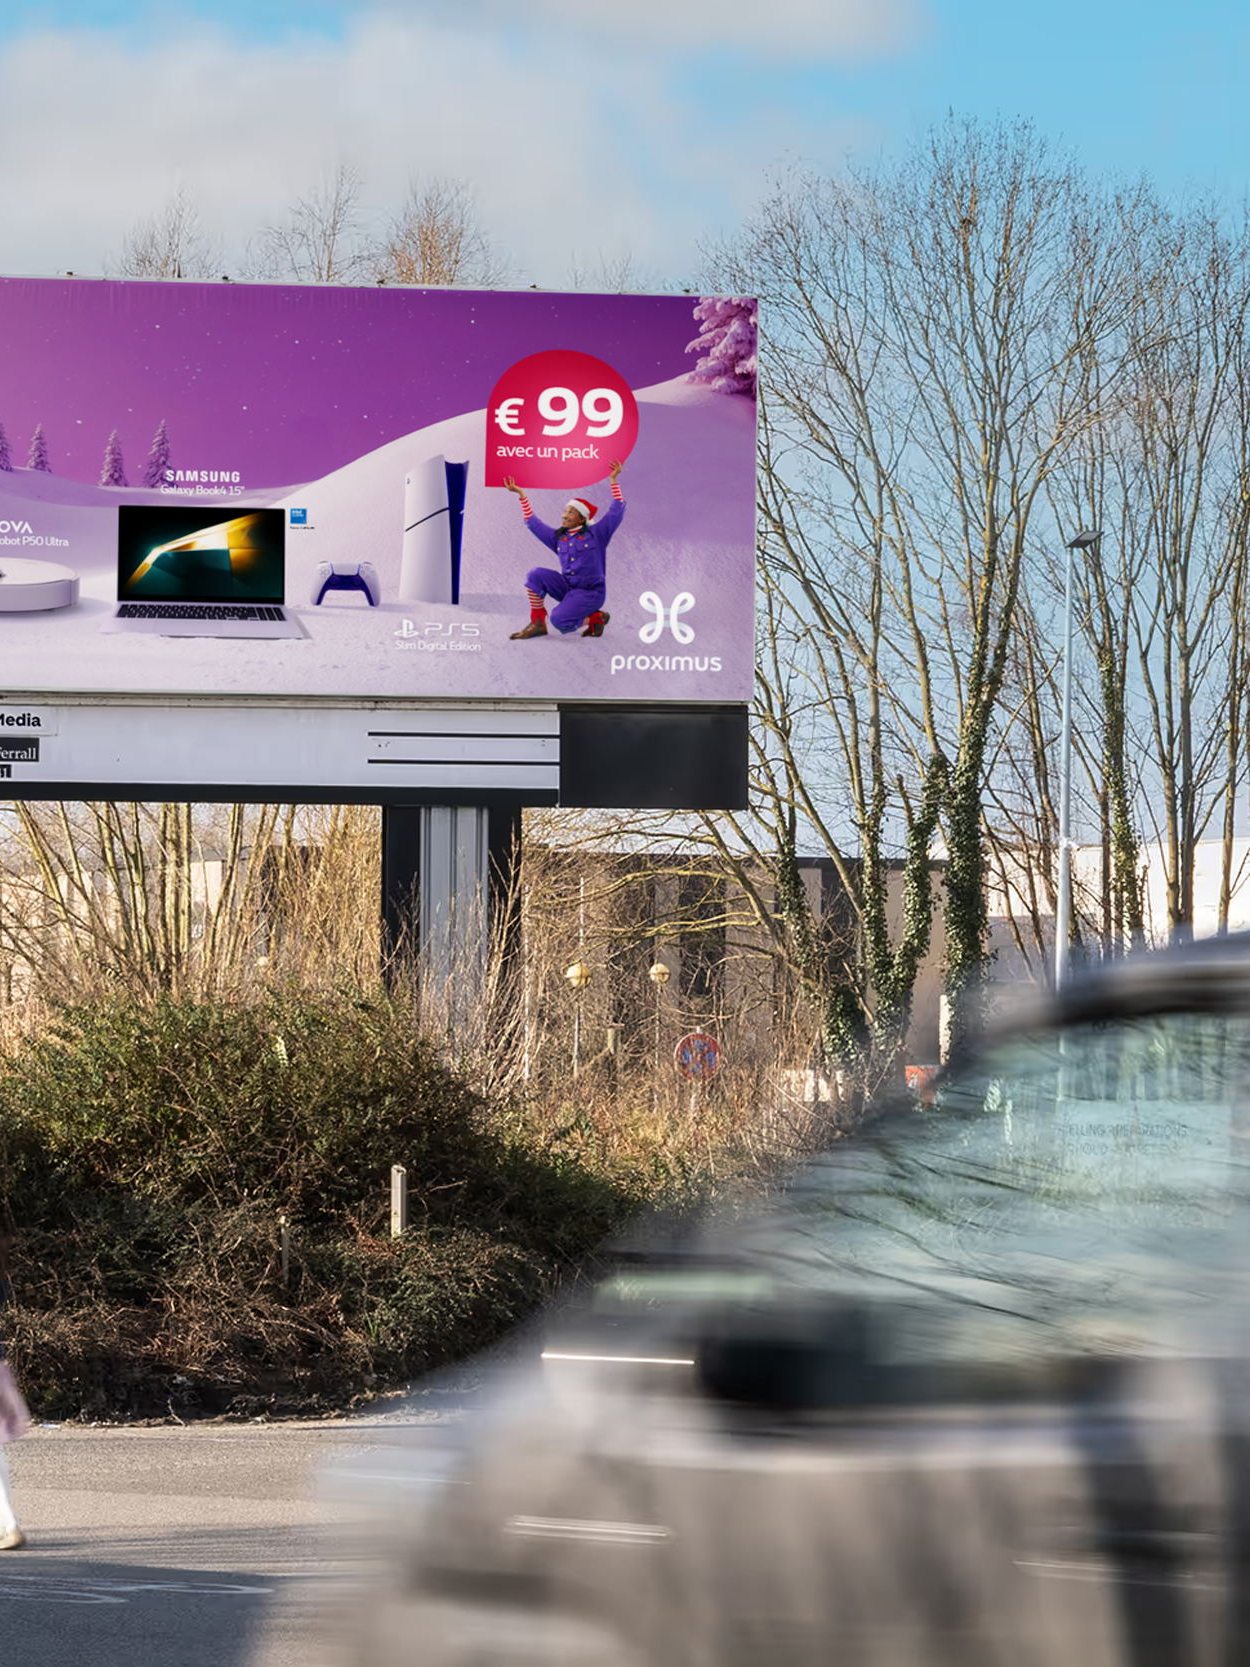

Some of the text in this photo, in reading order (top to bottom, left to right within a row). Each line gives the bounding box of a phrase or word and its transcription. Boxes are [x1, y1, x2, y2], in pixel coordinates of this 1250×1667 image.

[495, 387, 624, 437] € 99
[496, 444, 599, 461] avec un pack
[165, 470, 241, 483] SAMSUNG
[159, 484, 195, 497] Galaxy
[196, 485, 227, 496] Book4
[22, 536, 44, 546] P50
[45, 536, 69, 547] Ultra
[424, 622, 480, 636] PS5
[395, 640, 481, 652] Slim Digital Edition
[610, 655, 723, 675] proximus
